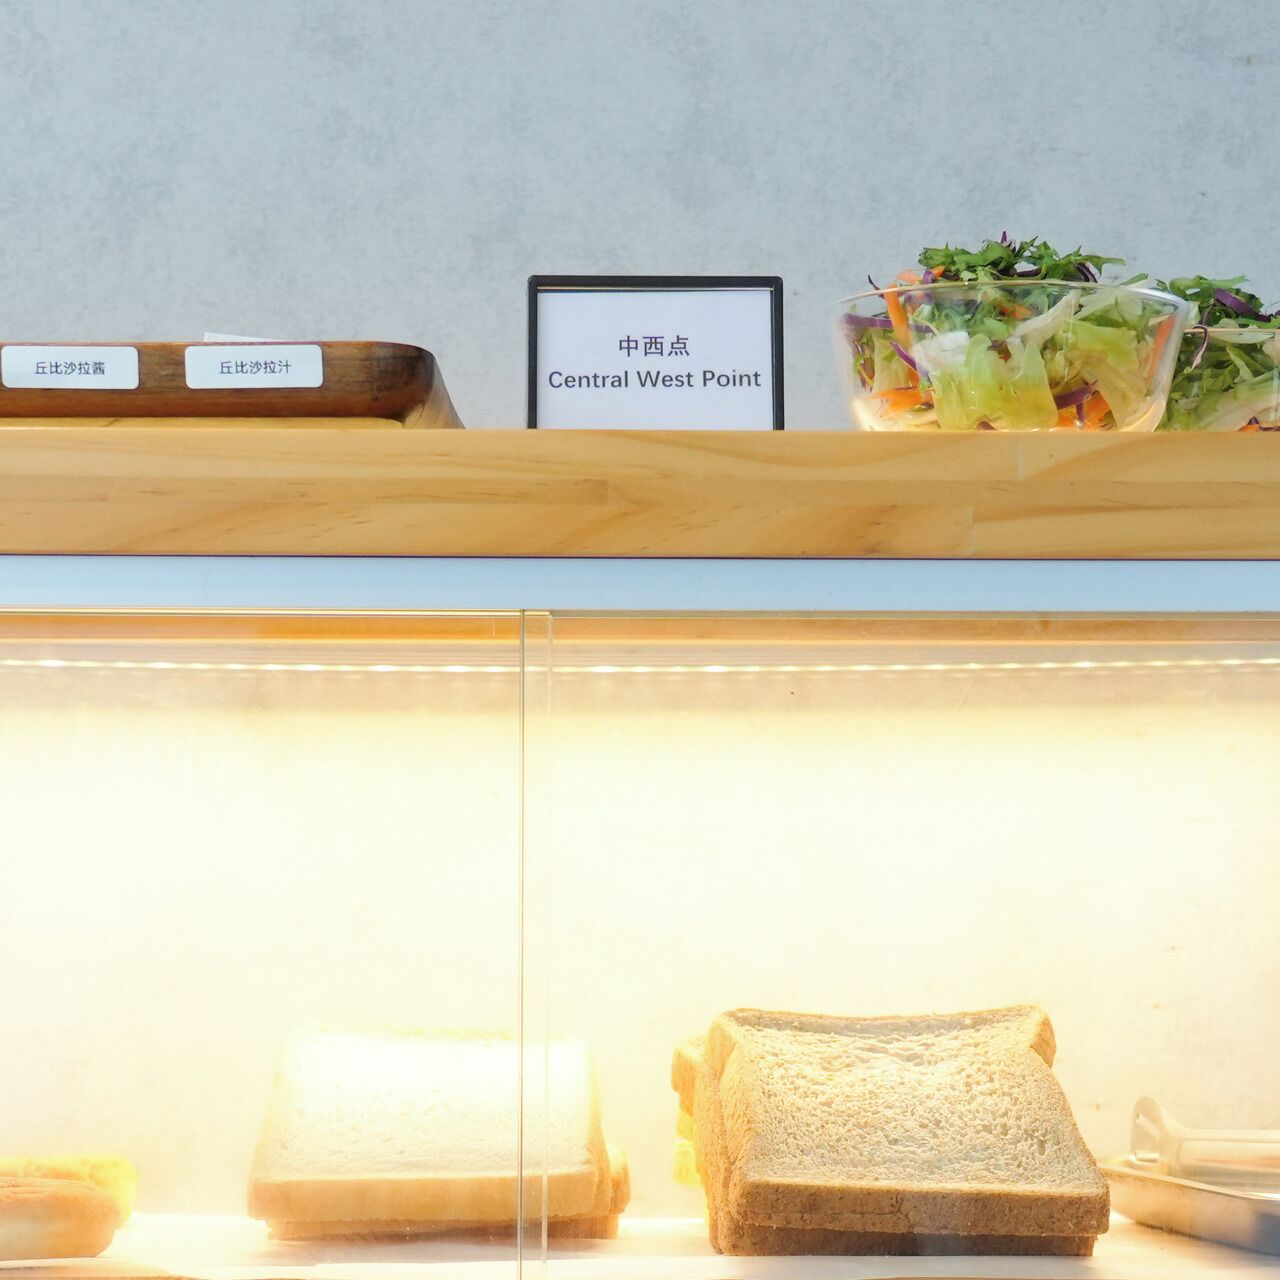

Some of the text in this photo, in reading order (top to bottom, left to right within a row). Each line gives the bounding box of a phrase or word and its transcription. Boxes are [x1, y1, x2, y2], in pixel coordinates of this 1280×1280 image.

[619, 335, 689, 357] 中西点
[35, 362, 104, 375] 丘比沙拉酱
[220, 360, 291, 374] 丘比沙拉汁
[549, 370, 761, 388] Central West Point
